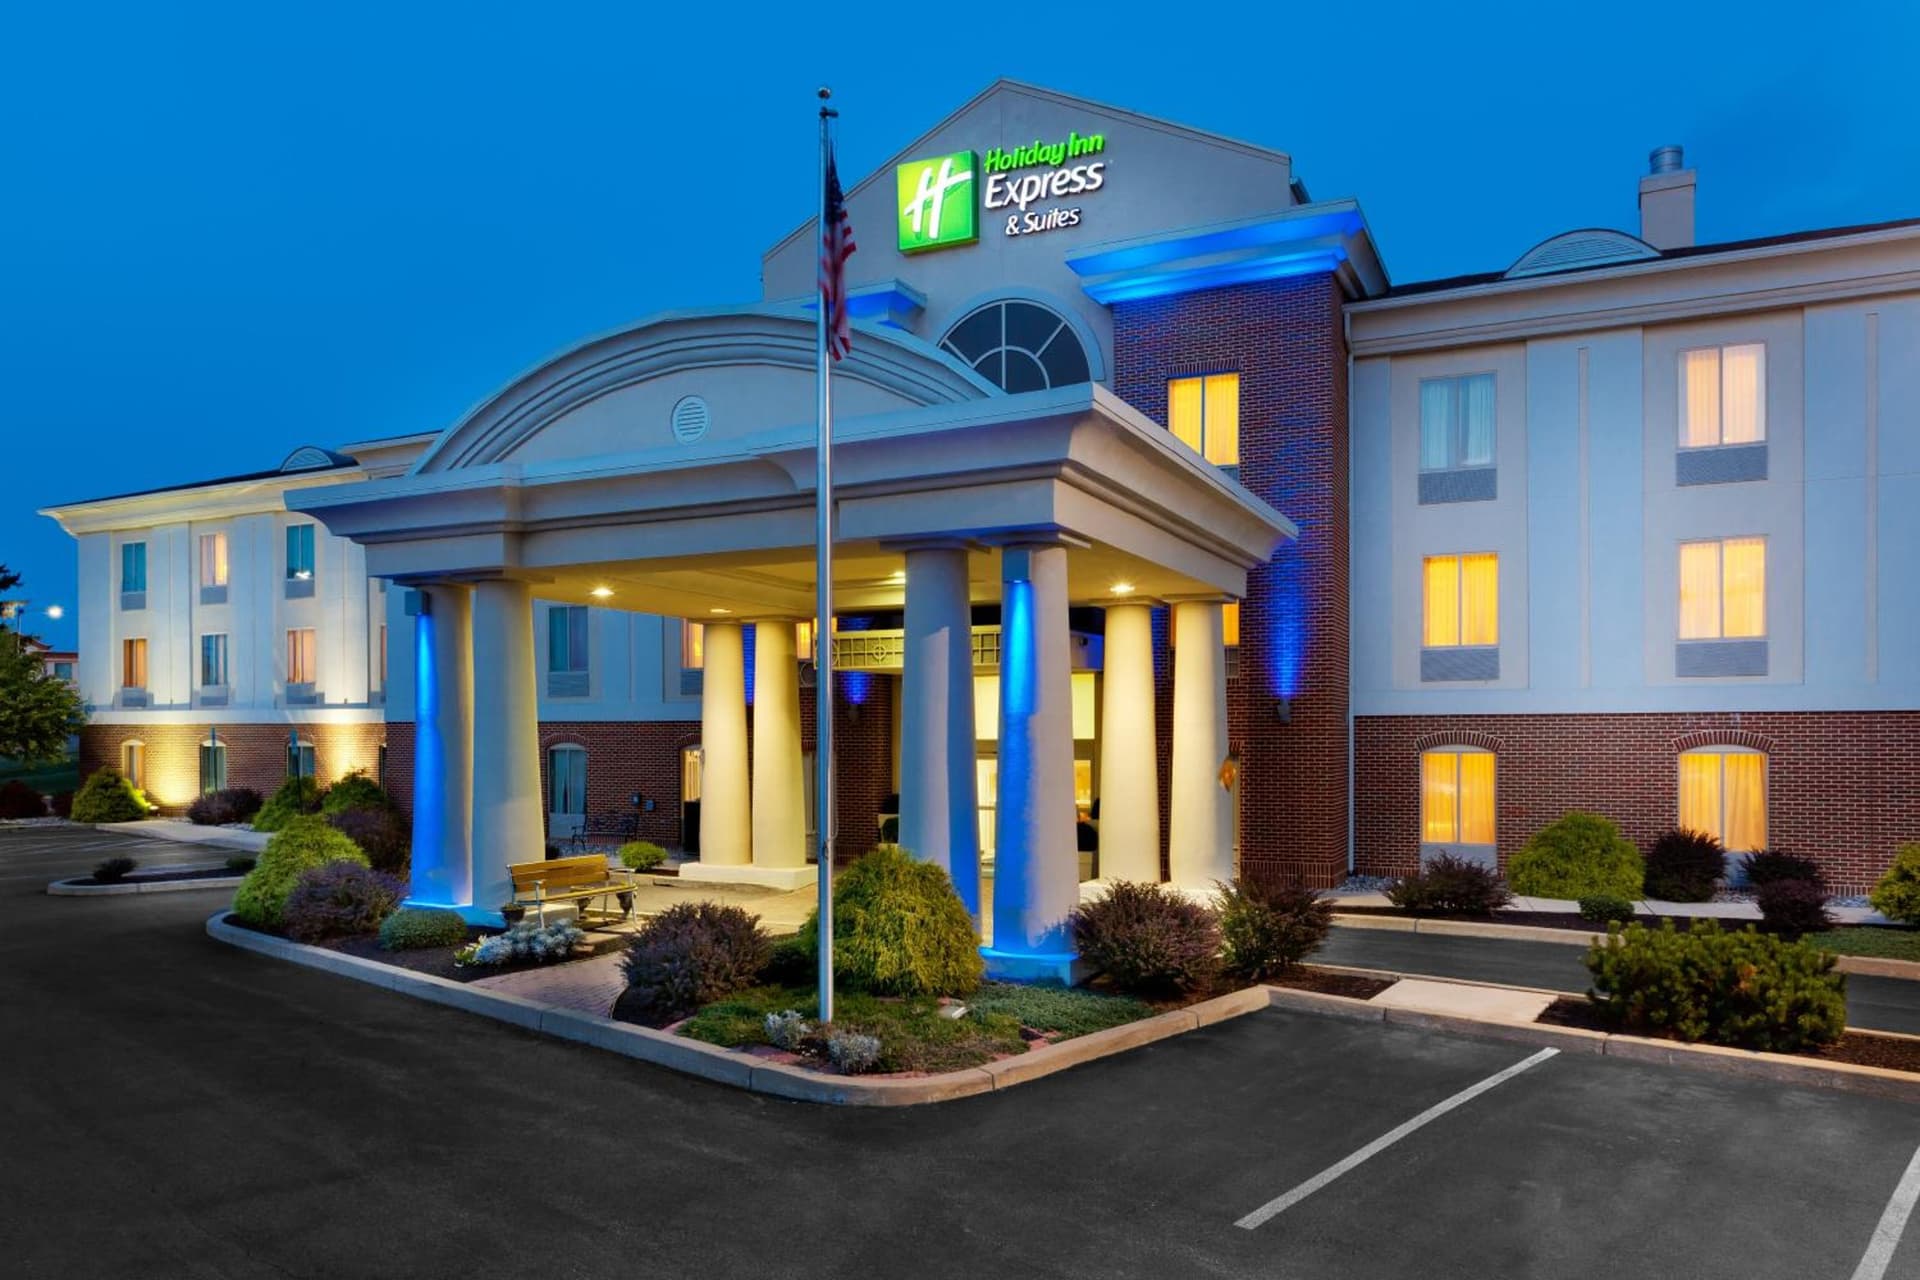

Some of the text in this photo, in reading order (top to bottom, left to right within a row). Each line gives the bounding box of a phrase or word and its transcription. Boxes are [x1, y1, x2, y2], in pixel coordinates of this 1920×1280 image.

[984, 132, 1104, 173] Holiday Inn
[984, 162, 1104, 210] Express
[1005, 207, 1080, 236] & Suites
